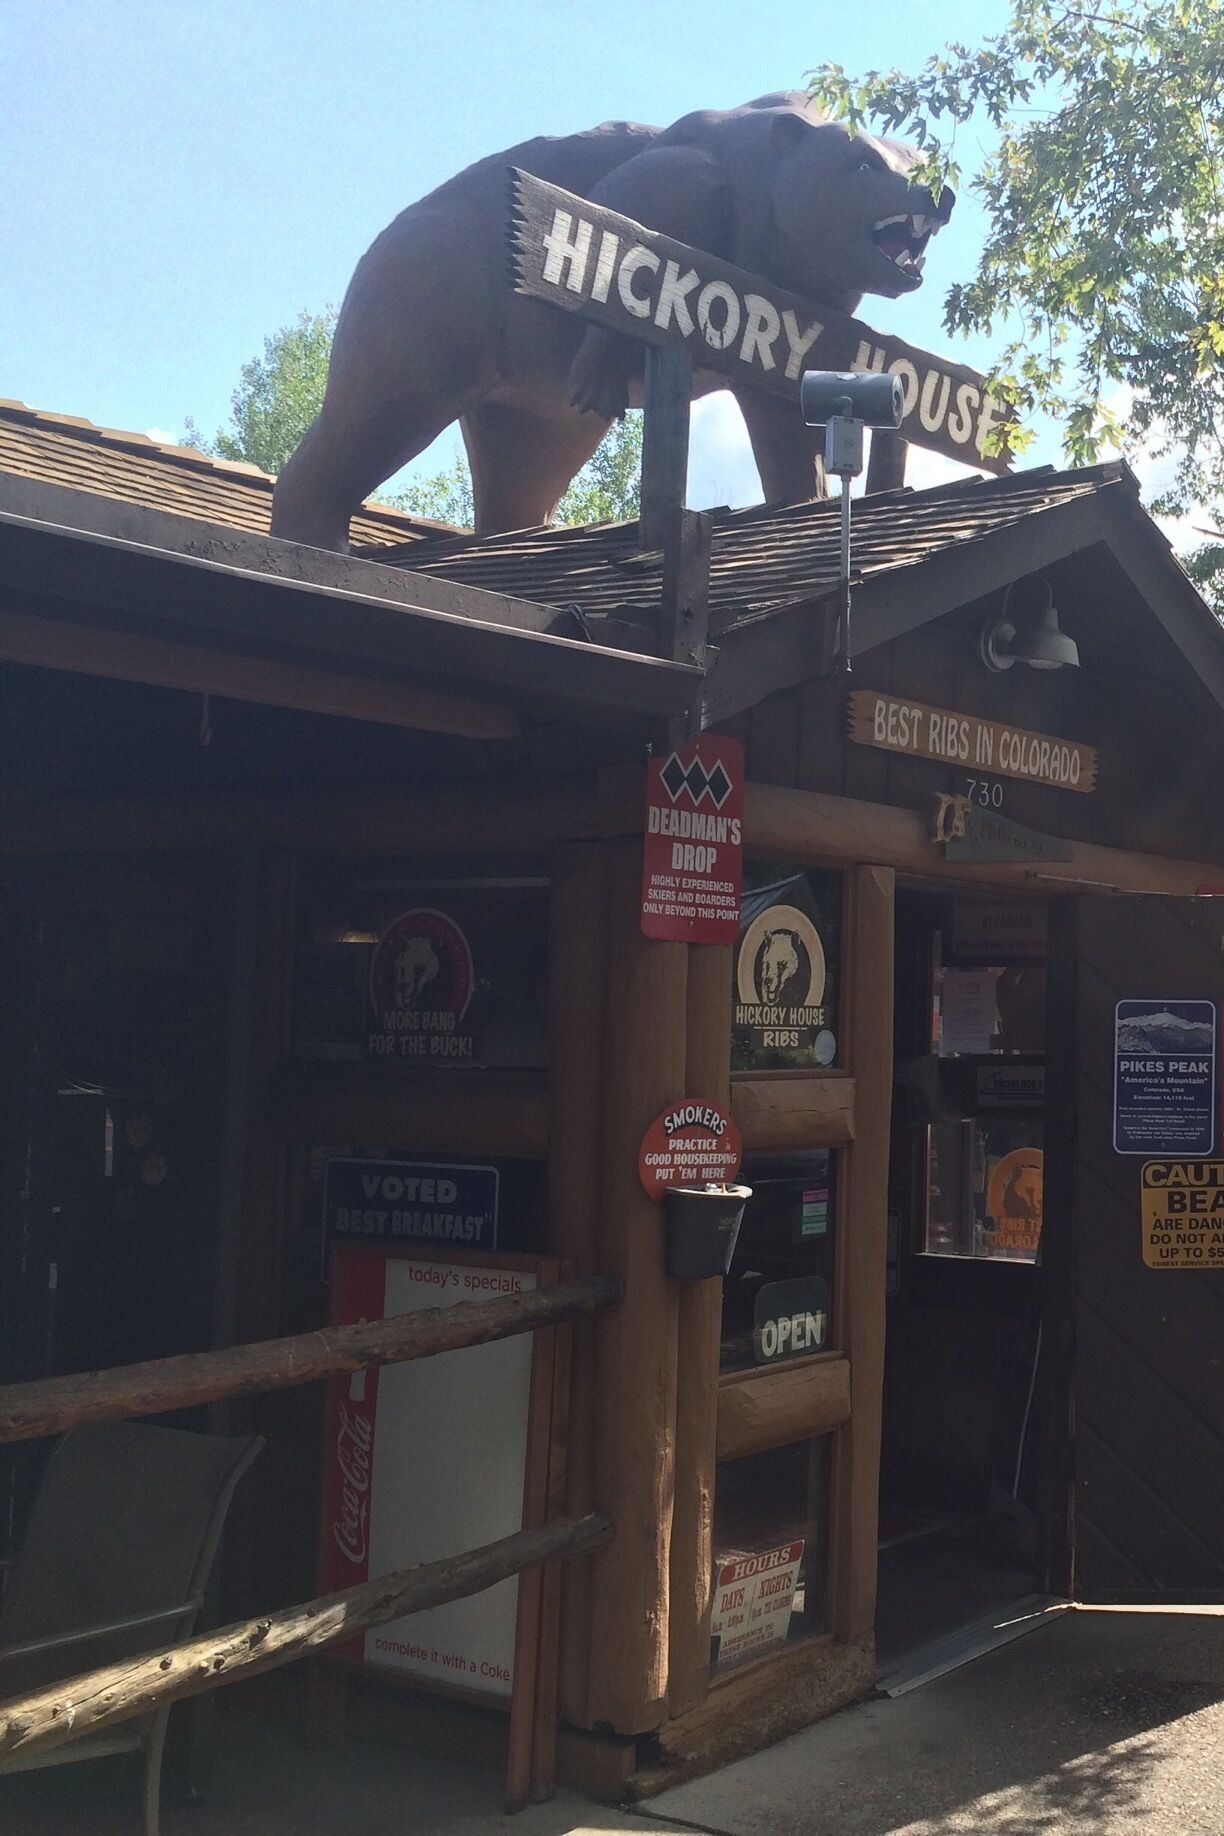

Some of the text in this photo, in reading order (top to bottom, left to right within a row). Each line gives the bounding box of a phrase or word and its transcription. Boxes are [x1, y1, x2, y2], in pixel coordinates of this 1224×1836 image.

[542, 207, 1007, 460] HICKORY HOUSE
[873, 700, 1081, 785] BEST RIBS IN COLORADO
[966, 779, 1003, 807] 730
[648, 806, 742, 845] DEADMAN'S
[672, 842, 717, 873] DROP
[651, 874, 734, 893] HIGHLY EXPERIENCED
[648, 888, 736, 907] SKIERS AND BOARDERS
[643, 902, 740, 921] ONLY BEYOND THIS POINT
[384, 1010, 456, 1031] MORE BANG
[736, 1006, 825, 1026] HICKORY HOUSE
[368, 1035, 473, 1058] FOR THE BUCK!
[763, 1030, 799, 1047] RIBS
[1120, 1061, 1209, 1073] PIKES PEAK
[664, 1105, 727, 1136] SMOKERS
[668, 1139, 718, 1150] PRACTICE
[645, 1153, 737, 1165] GOOD HOUSEKEEPING
[655, 1166, 726, 1180] PUT 'EM HERE
[362, 1175, 457, 1203] VOTED
[1152, 1218, 1183, 1230] ARE
[1150, 1233, 1171, 1245] DO
[1176, 1233, 1206, 1244] NOT
[1159, 1248, 1179, 1258] UP
[1183, 1247, 1203, 1258] TO
[409, 1267, 522, 1294] today's specials
[761, 1309, 822, 1357] OPEN
[334, 1404, 371, 1564] Coca-Cola
[732, 1547, 791, 1581] HOURS
[720, 1587, 745, 1614] DAYS
[758, 1570, 793, 1600] NIGHTS
[375, 1638, 510, 1681] complete it with a Coke
